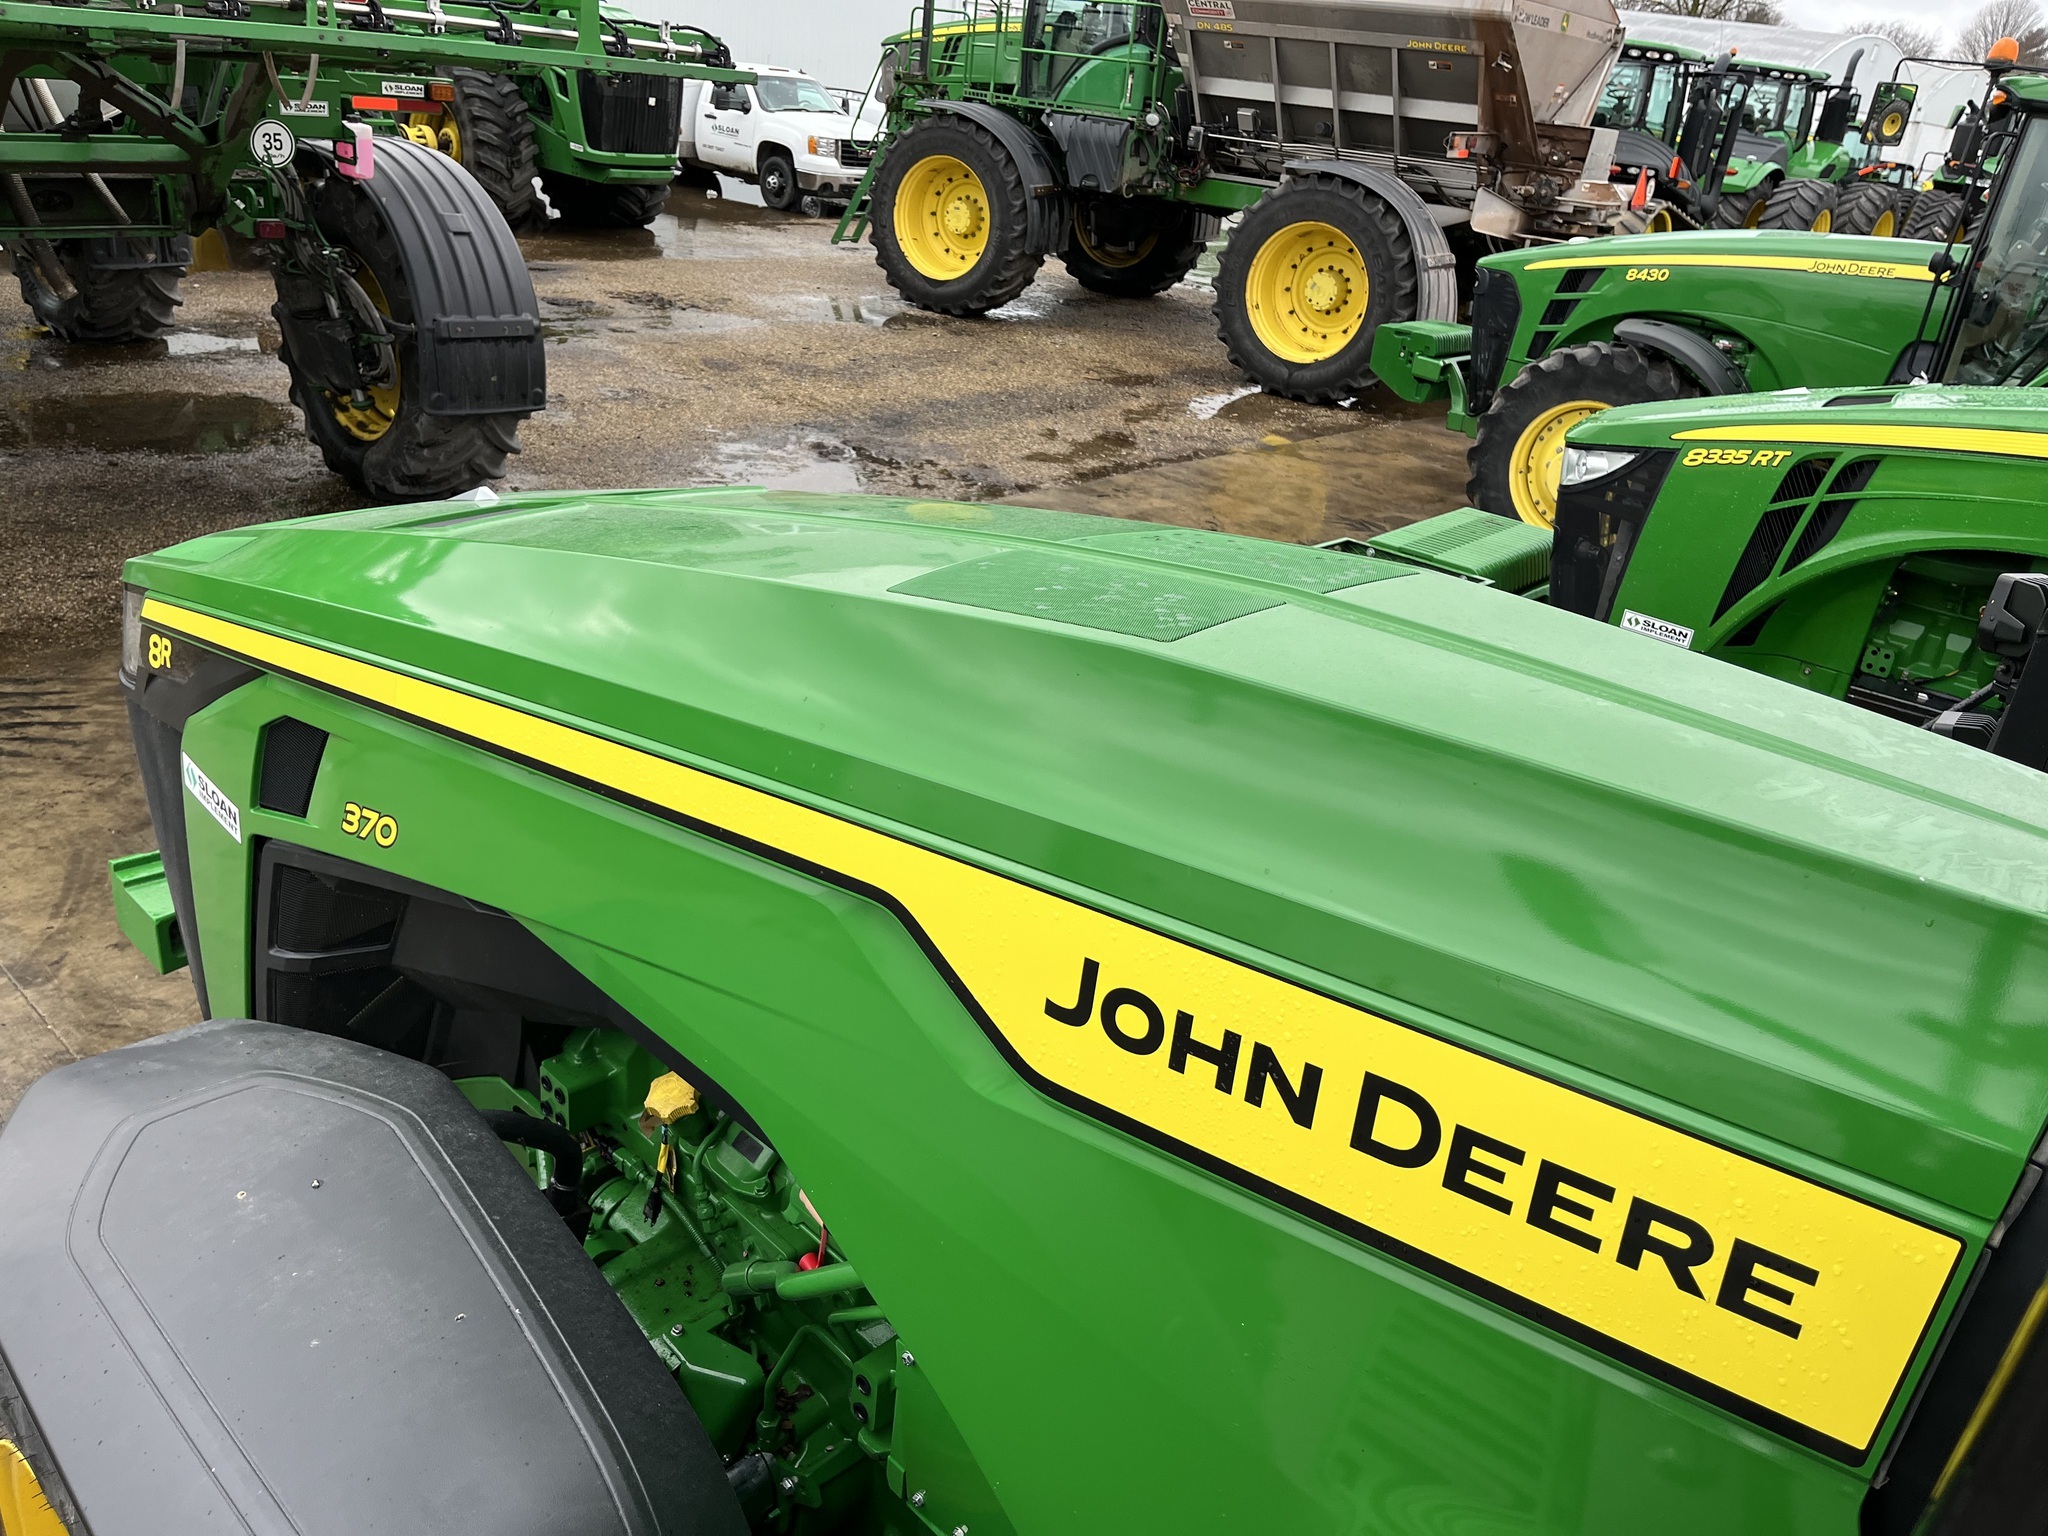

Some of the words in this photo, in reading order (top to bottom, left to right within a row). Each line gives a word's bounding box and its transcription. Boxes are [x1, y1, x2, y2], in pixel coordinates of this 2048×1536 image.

[1188, 0, 1231, 9] CENTRAL
[1197, 21, 1211, 30] DN
[1213, 23, 1233, 32] 485
[1406, 40, 1432, 49] JOHN
[1434, 42, 1467, 53] DEERE
[394, 84, 423, 92] SLOAN
[262, 132, 283, 151] 35
[1625, 268, 1670, 282] 8430
[1808, 260, 1847, 272] JOHN
[1847, 263, 1897, 277] DEERE
[1682, 447, 1754, 467] 8335
[1749, 450, 1793, 467] RT
[1640, 626, 1687, 644] IMPLEMENT
[1641, 619, 1689, 640] SLOAN
[148, 633, 172, 669] 8R
[198, 774, 238, 826] SLOAN
[199, 789, 238, 835] IMPLEMENT
[341, 801, 399, 849] 370
[1044, 957, 1323, 1130] JOHN
[1349, 1071, 1820, 1340] DEERE
